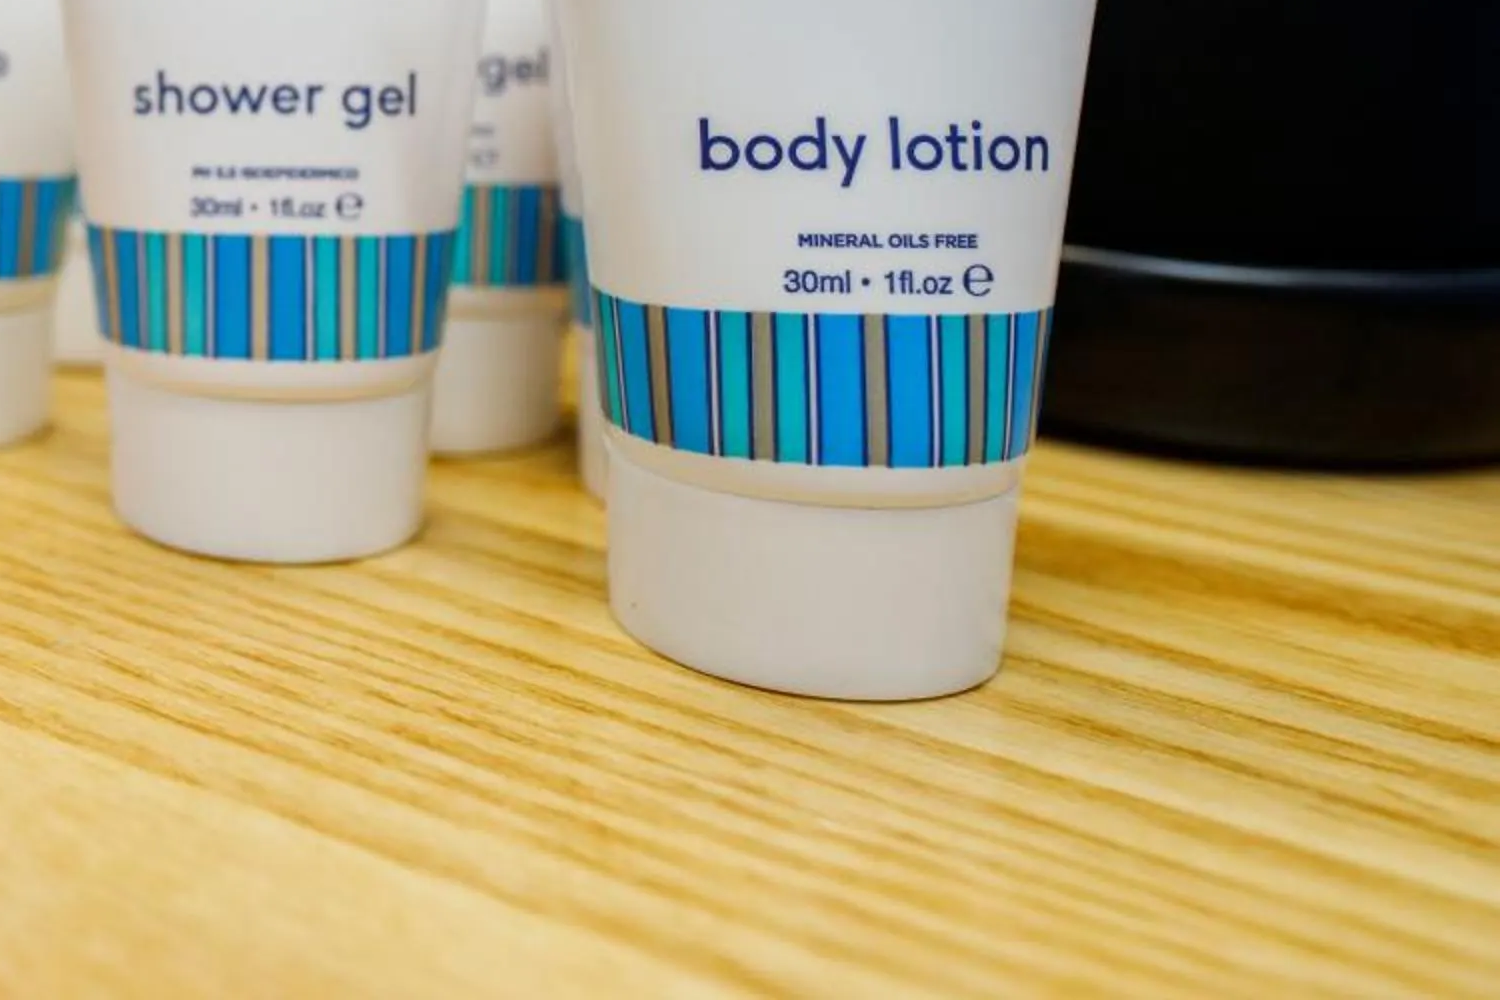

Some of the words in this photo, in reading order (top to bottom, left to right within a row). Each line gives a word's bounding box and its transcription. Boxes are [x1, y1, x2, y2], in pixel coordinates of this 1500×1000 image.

[134, 70, 324, 116] shower
[341, 72, 418, 130] gel
[698, 116, 867, 189] body
[888, 115, 1050, 172] lotion
[797, 233, 884, 249] MINERAL
[887, 233, 931, 249] OILS
[933, 233, 979, 250] FREE
[783, 268, 853, 295] 30ml
